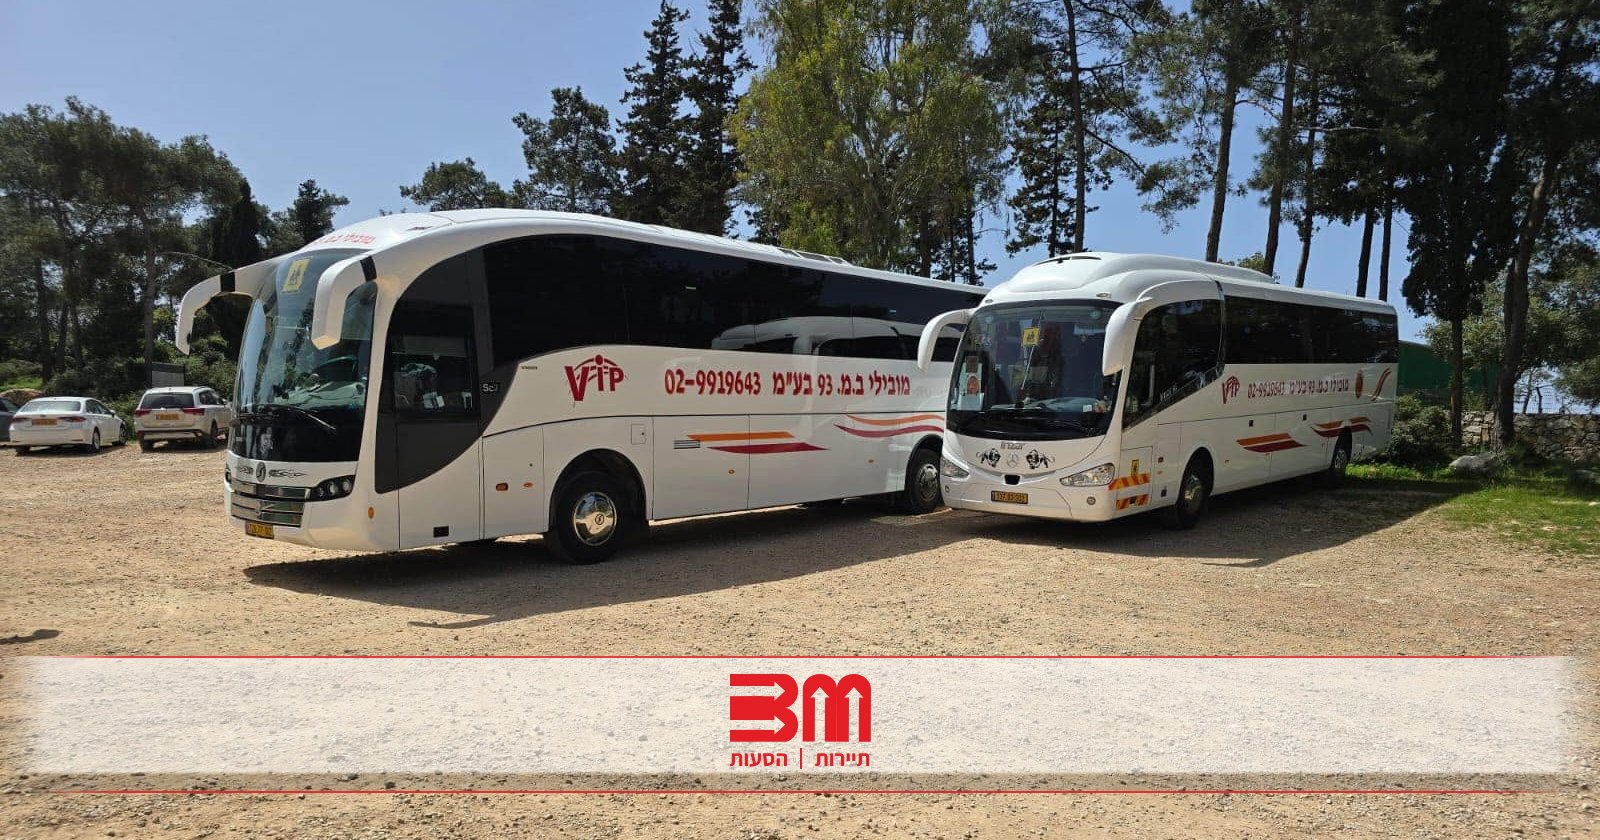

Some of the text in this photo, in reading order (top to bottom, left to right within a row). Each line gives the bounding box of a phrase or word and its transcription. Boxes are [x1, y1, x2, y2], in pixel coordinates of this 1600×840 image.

[663, 367, 762, 396] 02-9919643
[817, 375, 834, 396] 93
[869, 371, 911, 396] מובילי
